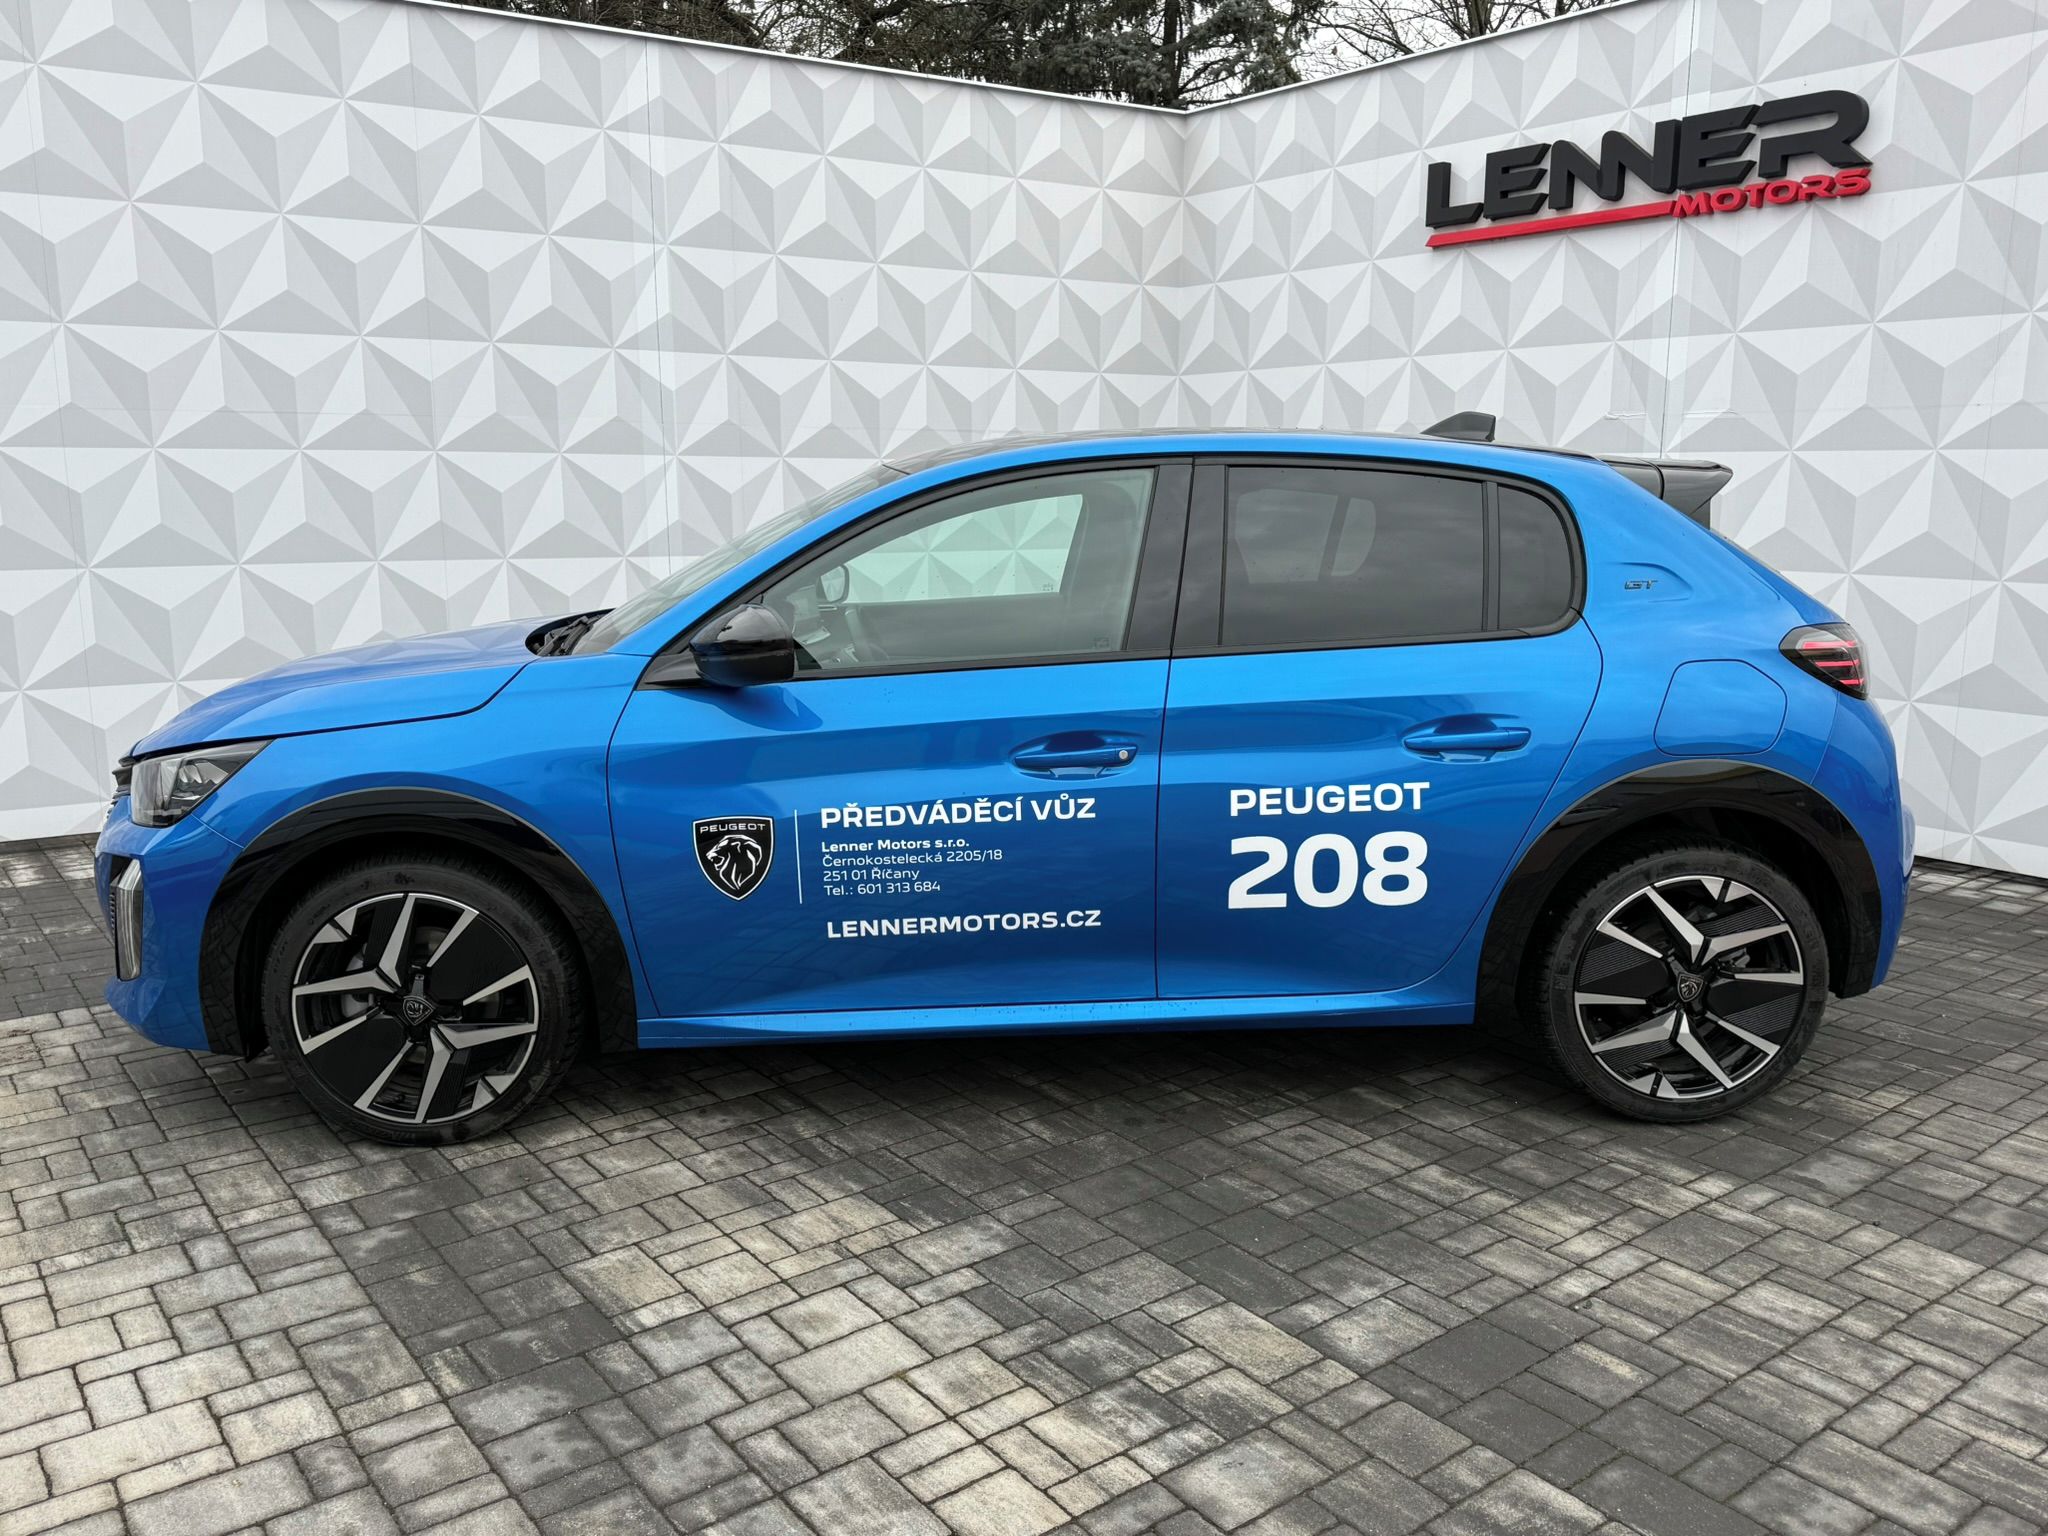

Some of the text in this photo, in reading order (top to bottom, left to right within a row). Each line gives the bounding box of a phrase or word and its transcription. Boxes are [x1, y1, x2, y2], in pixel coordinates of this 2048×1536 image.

[1425, 89, 1873, 229] LENNER
[1672, 167, 1873, 219] MOTORS
[1624, 580, 1658, 590] GT
[820, 793, 1096, 829] PŘEDVÁDĚCÍ VŮZ
[1230, 781, 1430, 817] PEUGEOT
[700, 823, 766, 834] PEUGEOT
[821, 838, 970, 853] Lenner Motors s.r.o.
[822, 849, 1003, 868] Černokostelecká 2205/18
[1228, 830, 1429, 910] 208
[823, 866, 920, 882] 251 01 Říčany
[824, 881, 941, 896] Tel.: 601 313 684
[827, 909, 1102, 939] LENNERMOTORS.CZ
